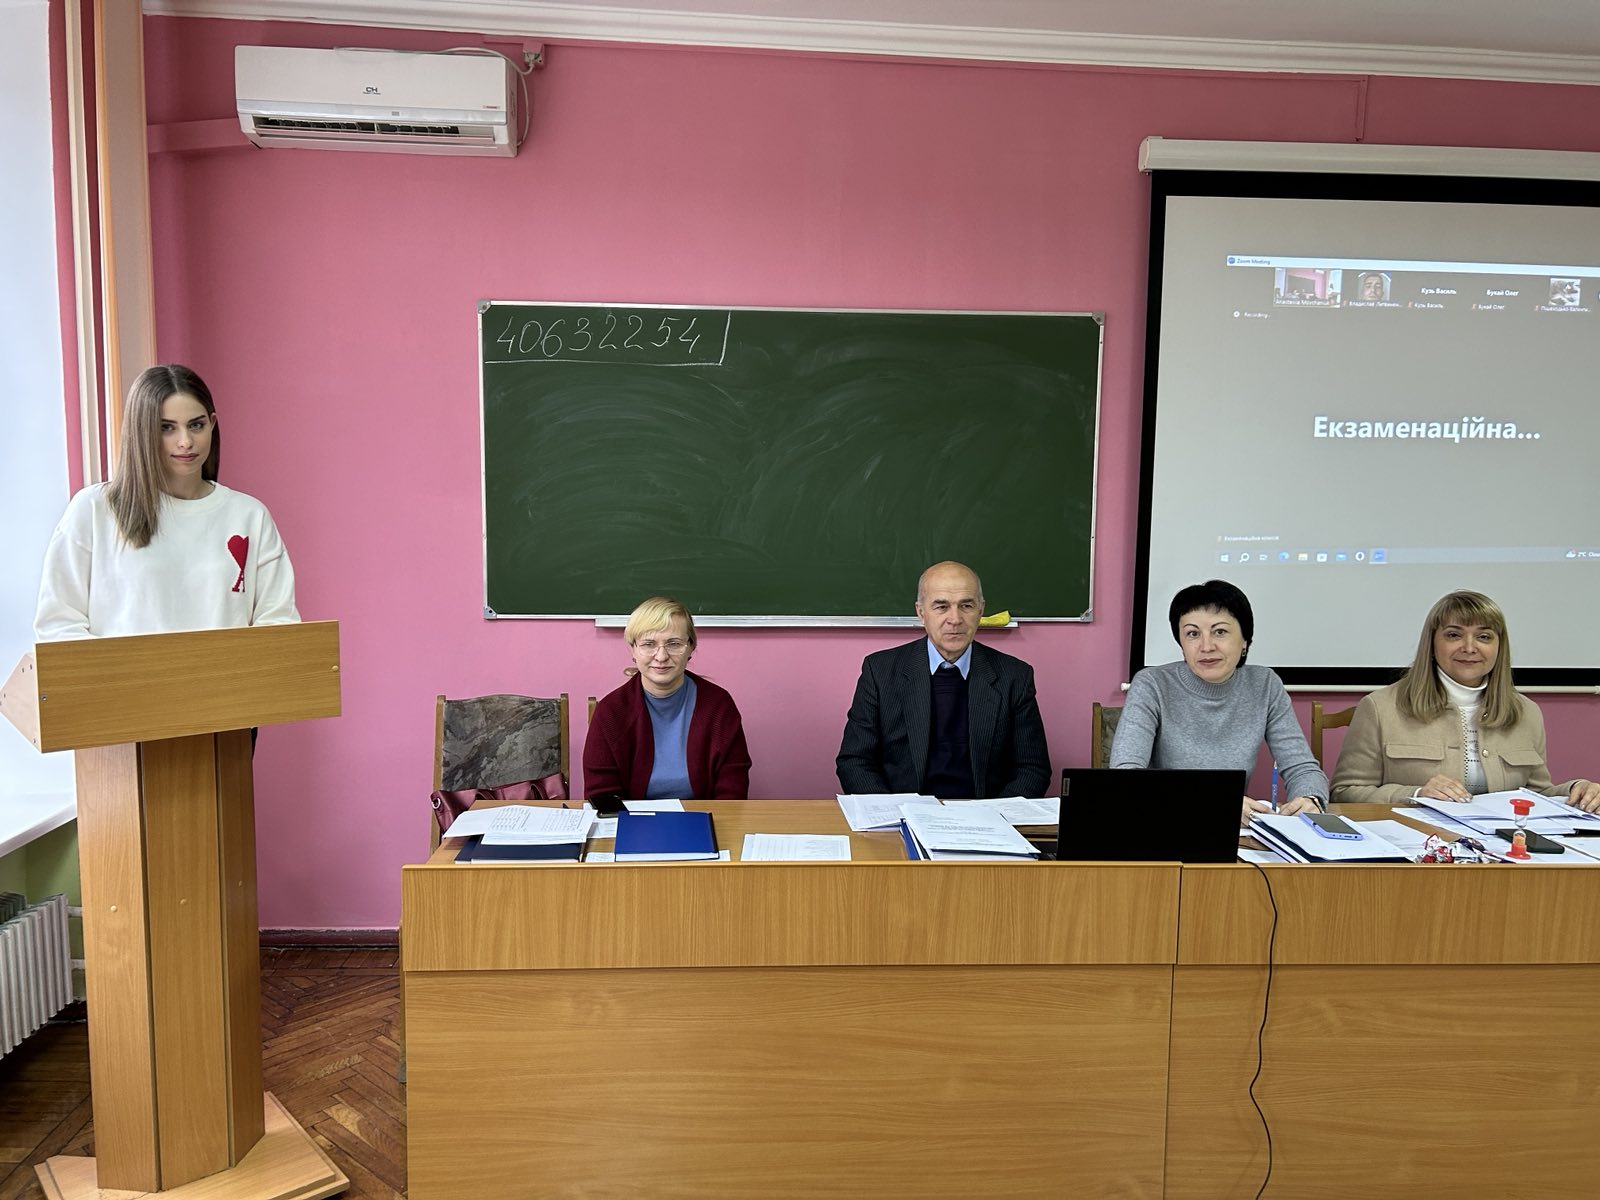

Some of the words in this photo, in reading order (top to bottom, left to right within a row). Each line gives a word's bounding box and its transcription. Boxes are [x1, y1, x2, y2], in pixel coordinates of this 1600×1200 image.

[1421, 287, 1435, 295] Кузь
[1435, 287, 1457, 295] Василь
[1504, 289, 1519, 297] Олег
[496, 314, 701, 358] 40632254
[1313, 415, 1541, 444] Екзаменаційна...
